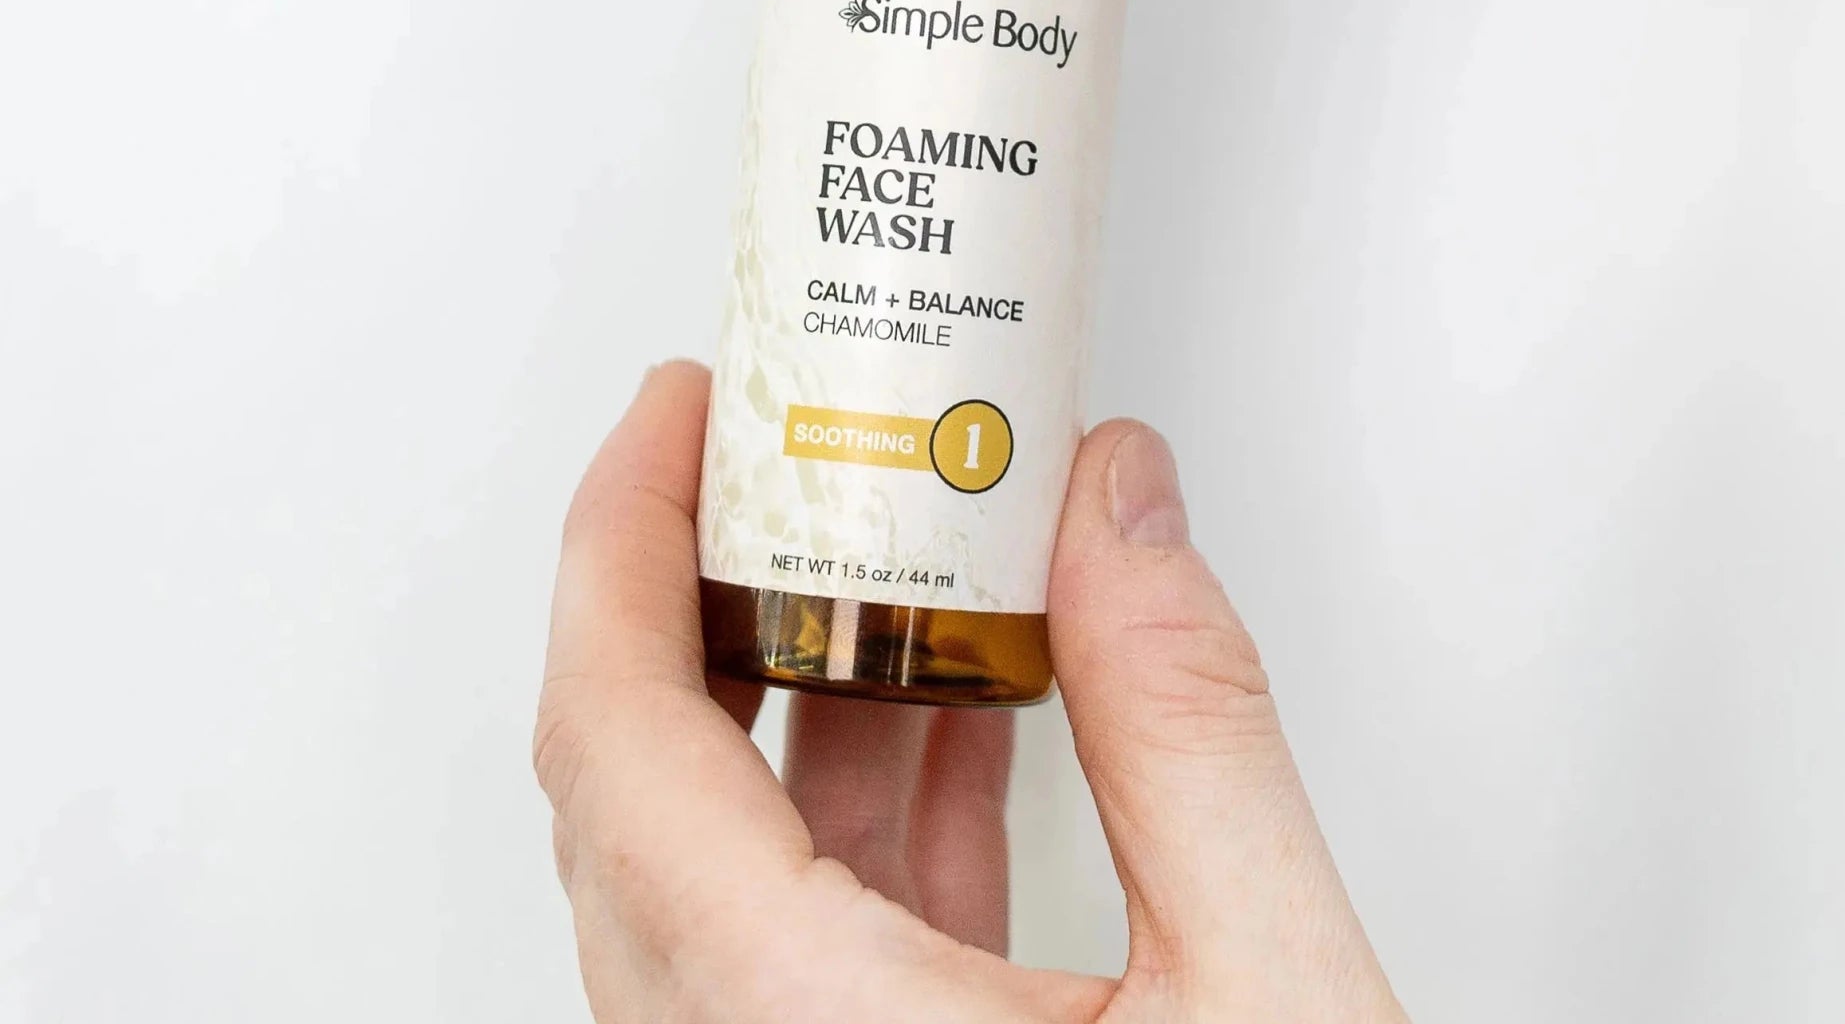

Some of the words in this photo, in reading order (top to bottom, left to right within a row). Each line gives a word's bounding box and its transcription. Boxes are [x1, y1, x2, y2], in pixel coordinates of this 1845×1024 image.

[993, 9, 1077, 68] Body
[824, 120, 1038, 176] FOAMING
[819, 164, 936, 208] FACE
[816, 207, 954, 254] WASH
[807, 279, 876, 306] CALM
[885, 293, 900, 308] +
[908, 290, 1024, 322] BALANCE
[803, 311, 952, 347] CHAMOMILE
[793, 423, 916, 455] SOOTHING
[963, 423, 981, 469] 1
[771, 553, 804, 571] NET
[808, 558, 836, 575] WT
[842, 563, 866, 580] 1.5
[872, 569, 892, 582] oz
[896, 568, 905, 584] /
[908, 570, 929, 585] 44
[934, 572, 955, 588] ml
